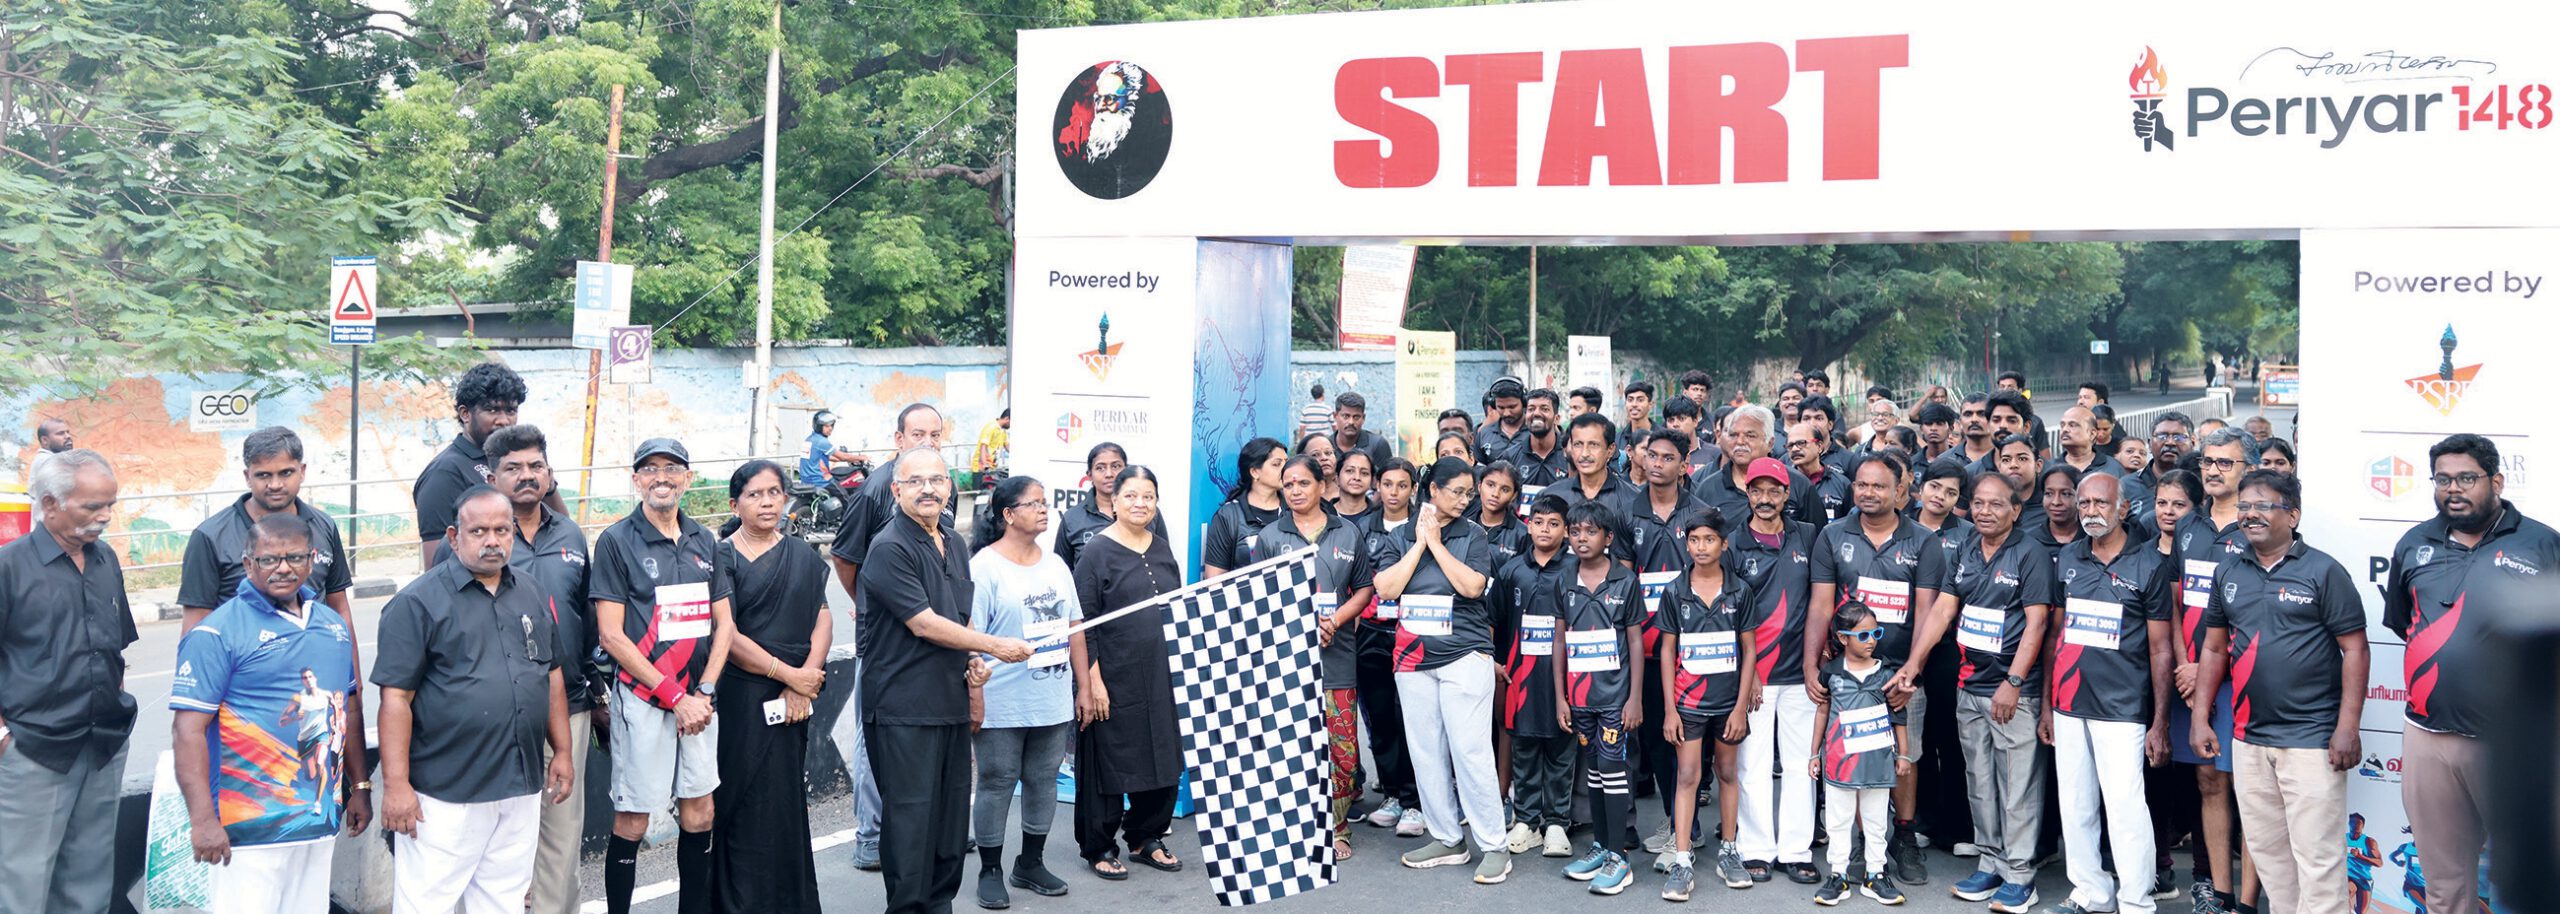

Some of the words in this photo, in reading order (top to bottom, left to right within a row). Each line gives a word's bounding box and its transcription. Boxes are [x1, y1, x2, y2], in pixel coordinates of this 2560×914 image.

[1333, 33, 1909, 189] START
[2187, 86, 2443, 149] Periyar
[2451, 84, 2553, 131] 148
[1048, 269, 1131, 289] Powered
[1136, 270, 1160, 293] by
[2354, 271, 2493, 293] Powered
[2504, 271, 2542, 299] by
[622, 334, 637, 356] 4
[200, 394, 249, 416] GEO
[1093, 409, 1148, 424] PERIYAR
[2502, 557, 2540, 577] Periyar
[1868, 593, 1889, 604] PWCH
[2285, 592, 2314, 605] Periyar
[1413, 608, 1432, 617] PWCH
[1965, 619, 1982, 631] PWCH
[2077, 616, 2097, 628] PWCH
[1532, 629, 1552, 639] PWCH
[1578, 645, 1597, 654] PWCH
[1695, 646, 1716, 656] PWCH
[1856, 720, 1877, 733] PWCH
